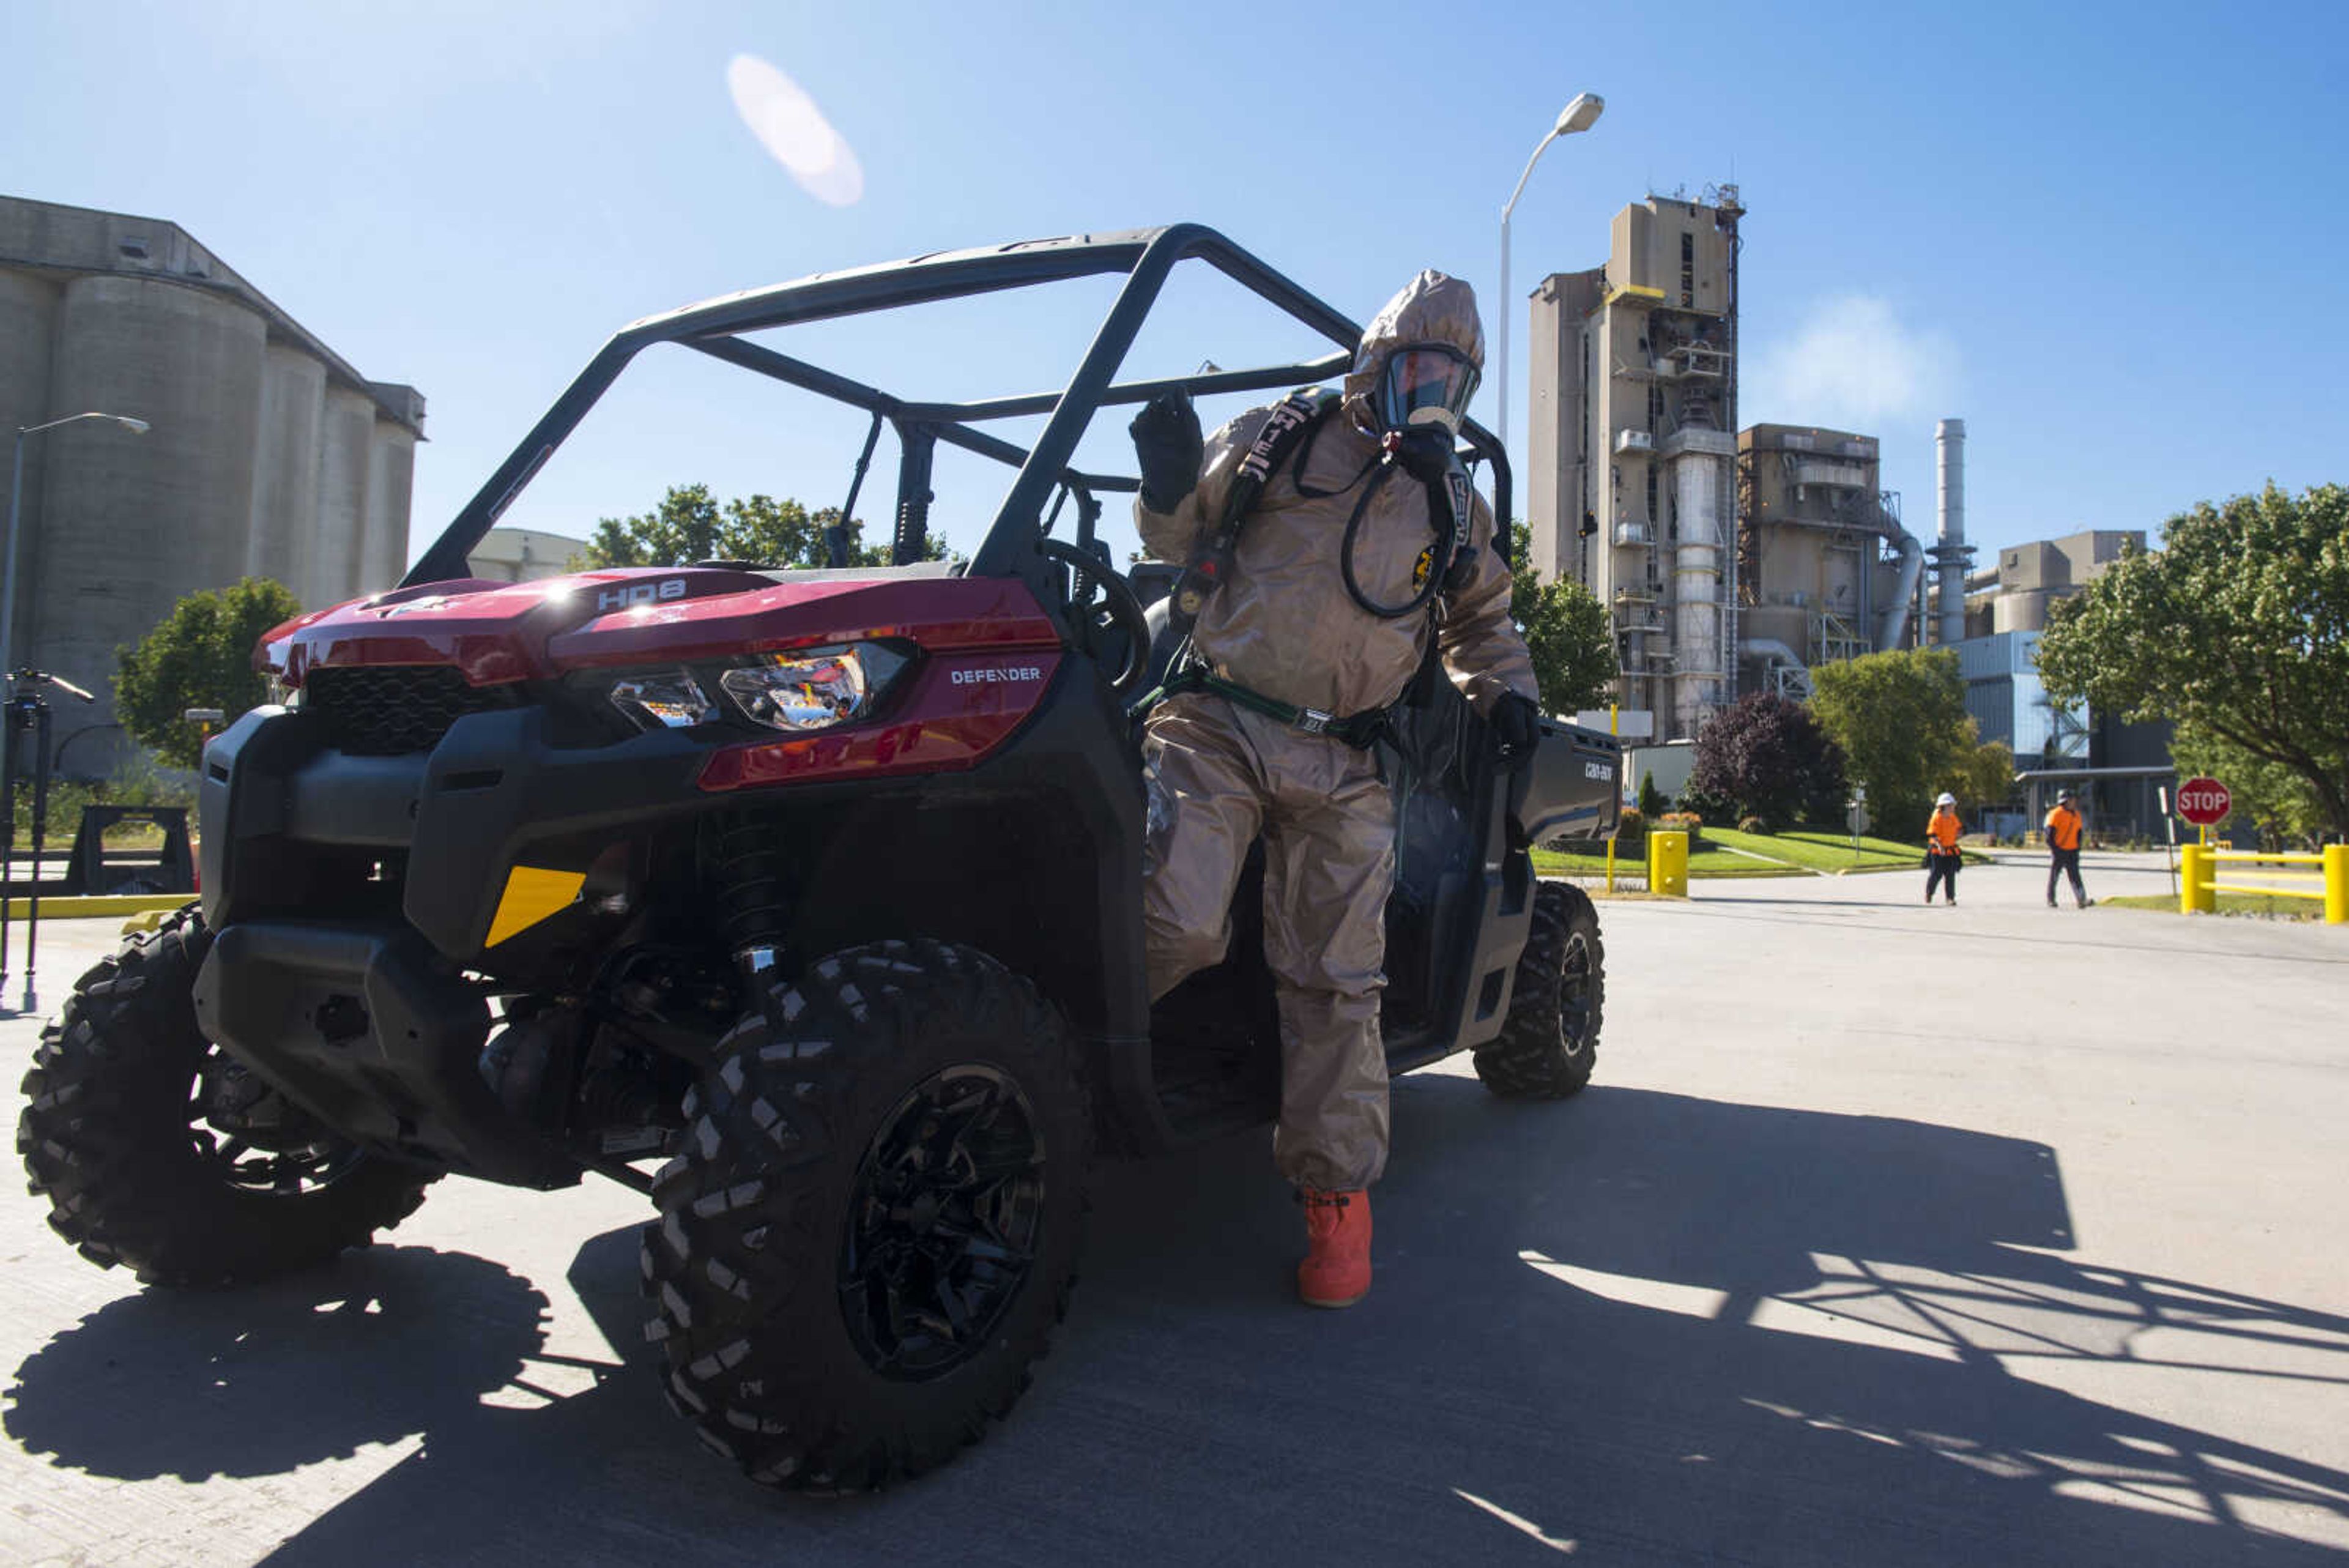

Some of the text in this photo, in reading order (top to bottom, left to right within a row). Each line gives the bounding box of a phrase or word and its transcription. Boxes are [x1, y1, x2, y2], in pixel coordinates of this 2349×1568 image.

[598, 579, 686, 610] HD8
[951, 667, 1041, 685] DEFENDER
[2180, 792, 2227, 811] STOP
